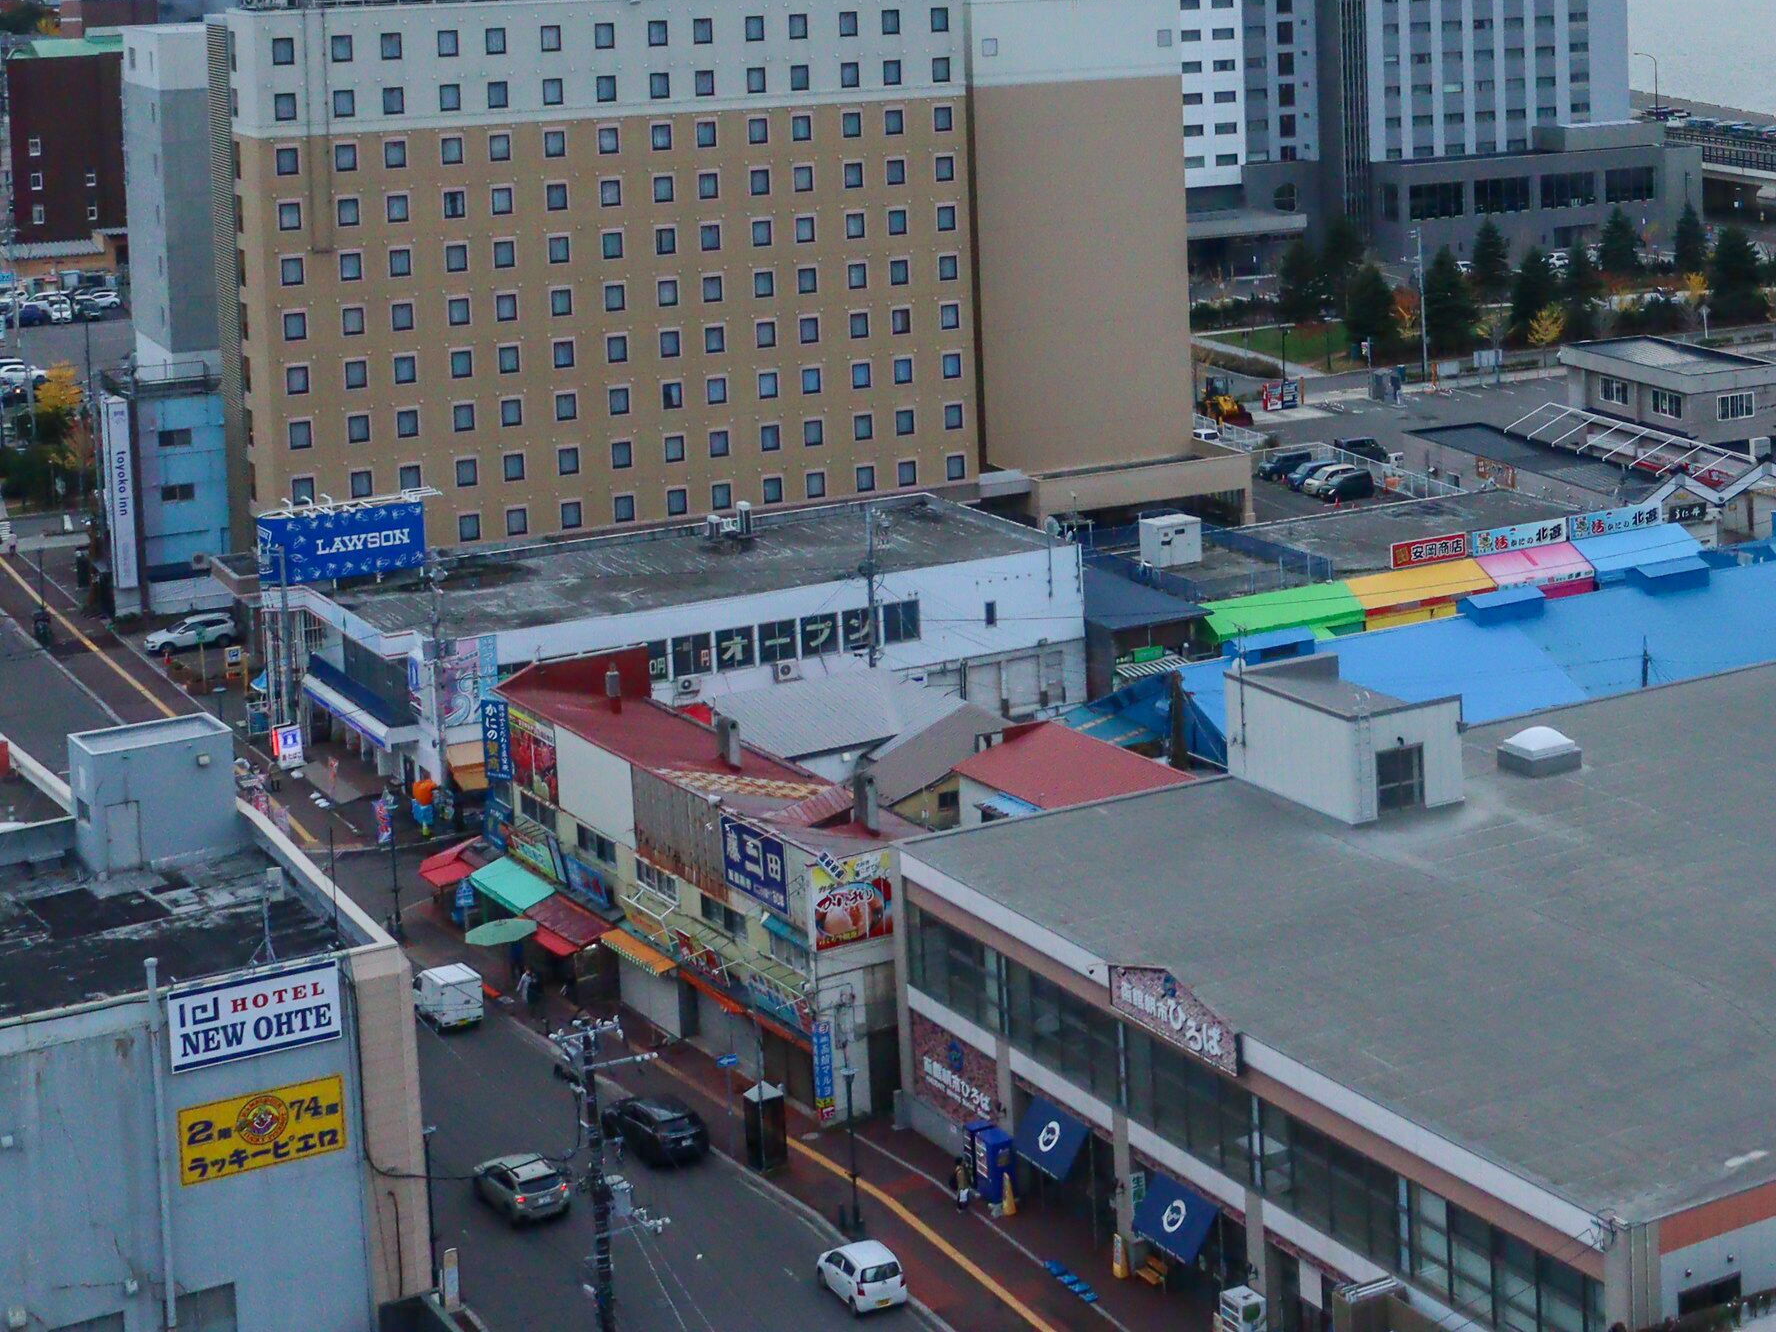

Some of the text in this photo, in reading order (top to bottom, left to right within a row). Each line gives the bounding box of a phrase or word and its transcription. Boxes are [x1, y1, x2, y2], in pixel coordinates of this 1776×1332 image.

[115, 450, 129, 516] toyoko inn
[316, 528, 411, 555] LAWSON
[1411, 538, 1464, 560] 安岡商店
[720, 619, 872, 661] オープン
[231, 982, 325, 1014] HOTEL
[180, 1003, 332, 1057] NEW OHTE
[187, 1129, 339, 1178] ラッキーピエロ
